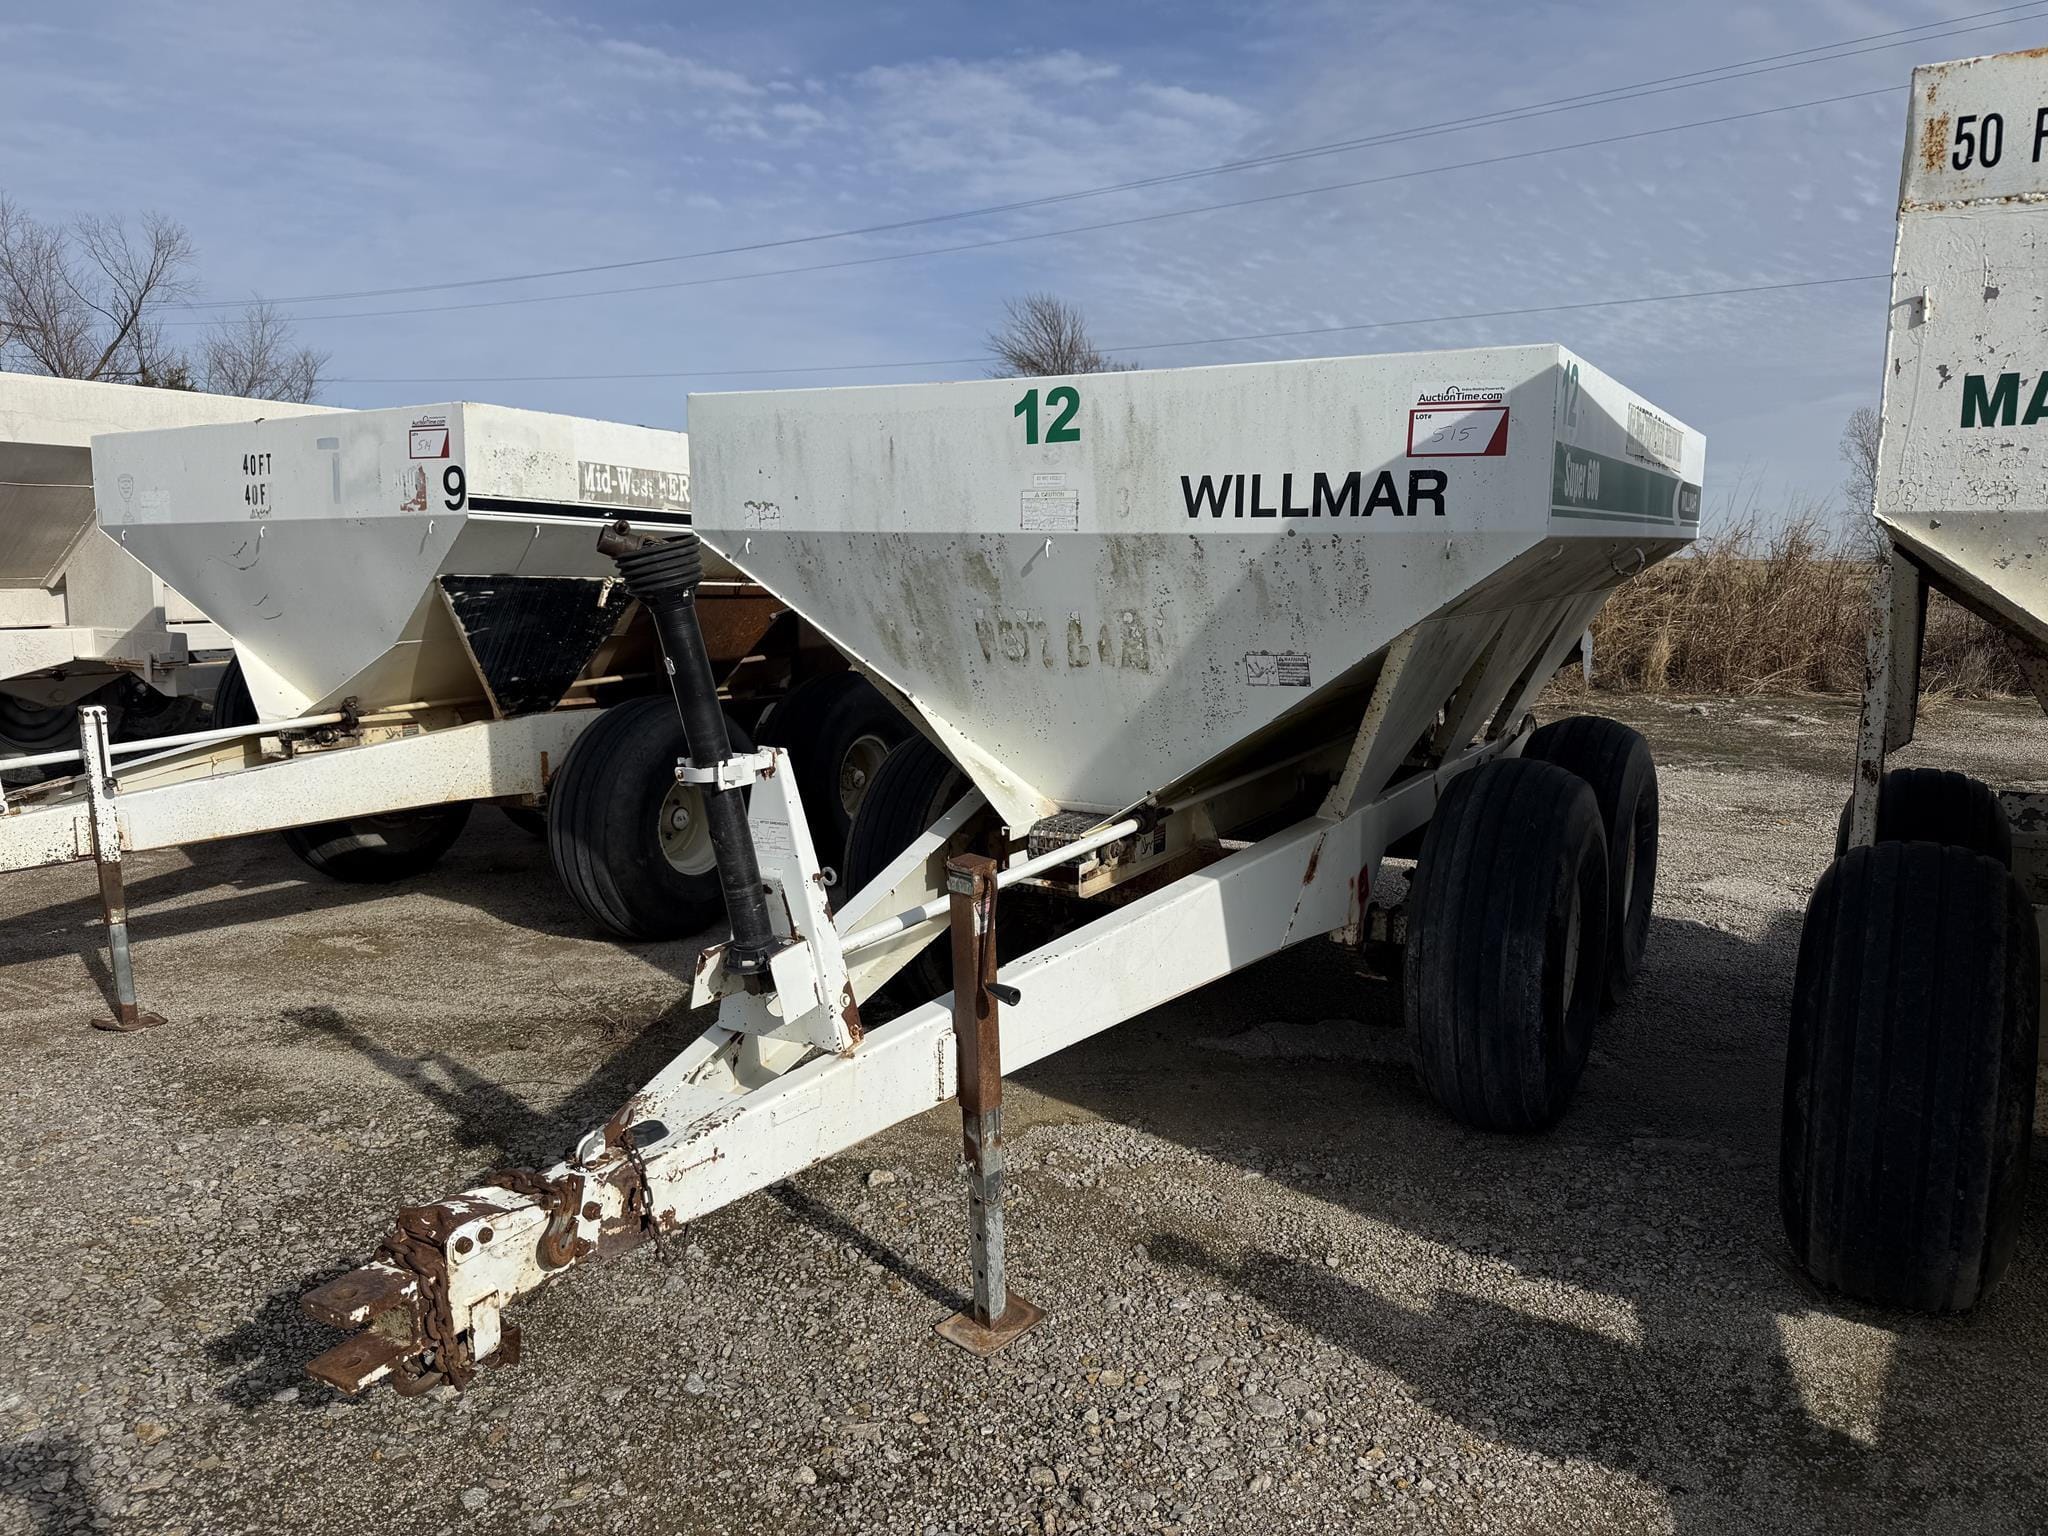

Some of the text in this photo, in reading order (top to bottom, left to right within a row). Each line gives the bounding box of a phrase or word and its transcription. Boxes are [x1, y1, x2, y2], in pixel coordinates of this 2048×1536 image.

[1952, 113, 2003, 171] 50
[1014, 386, 1080, 444] 12
[1418, 391, 1503, 402] AuctionTime.com
[1563, 360, 1579, 428] 12
[1432, 426, 1477, 442] 515
[443, 465, 466, 511] 9
[1180, 470, 1448, 518] WILLMAR
